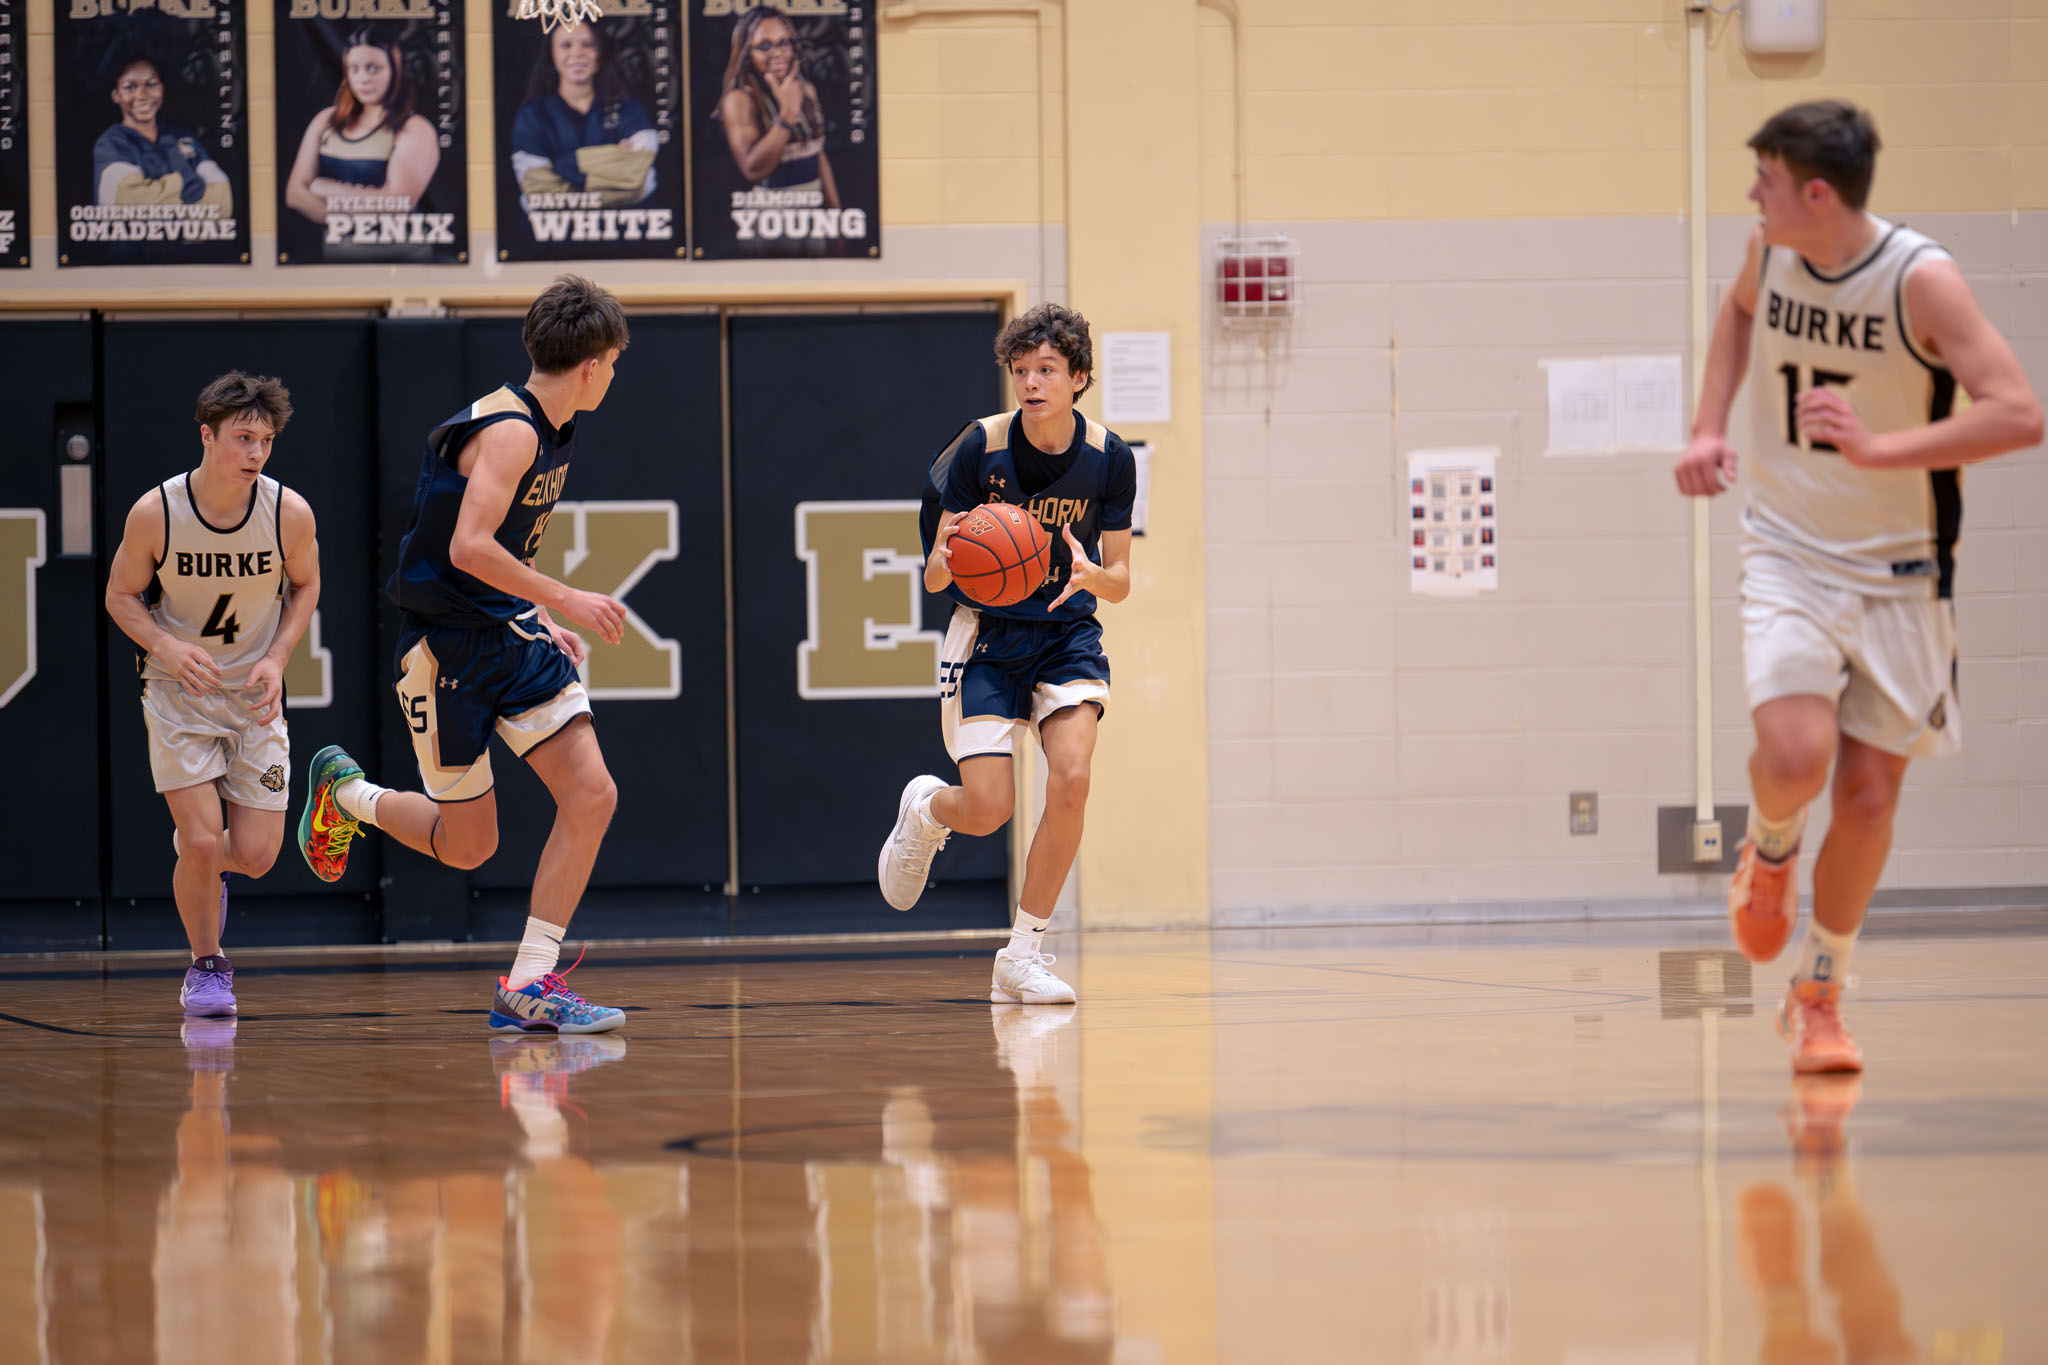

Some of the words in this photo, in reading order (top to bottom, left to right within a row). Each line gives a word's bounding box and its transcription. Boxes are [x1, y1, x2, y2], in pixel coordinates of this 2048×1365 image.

[219, 0, 234, 149] RESTLING
[437, 0, 452, 148] RESTLING
[731, 191, 825, 208] DIAMOND
[70, 219, 237, 241] OMADEVUAE
[325, 213, 455, 244] PENIX
[528, 209, 673, 242] WHITE
[730, 208, 867, 239] YOUNG
[1767, 289, 1886, 353] BURKE
[176, 550, 273, 578] BURKE
[200, 592, 240, 644] 4
